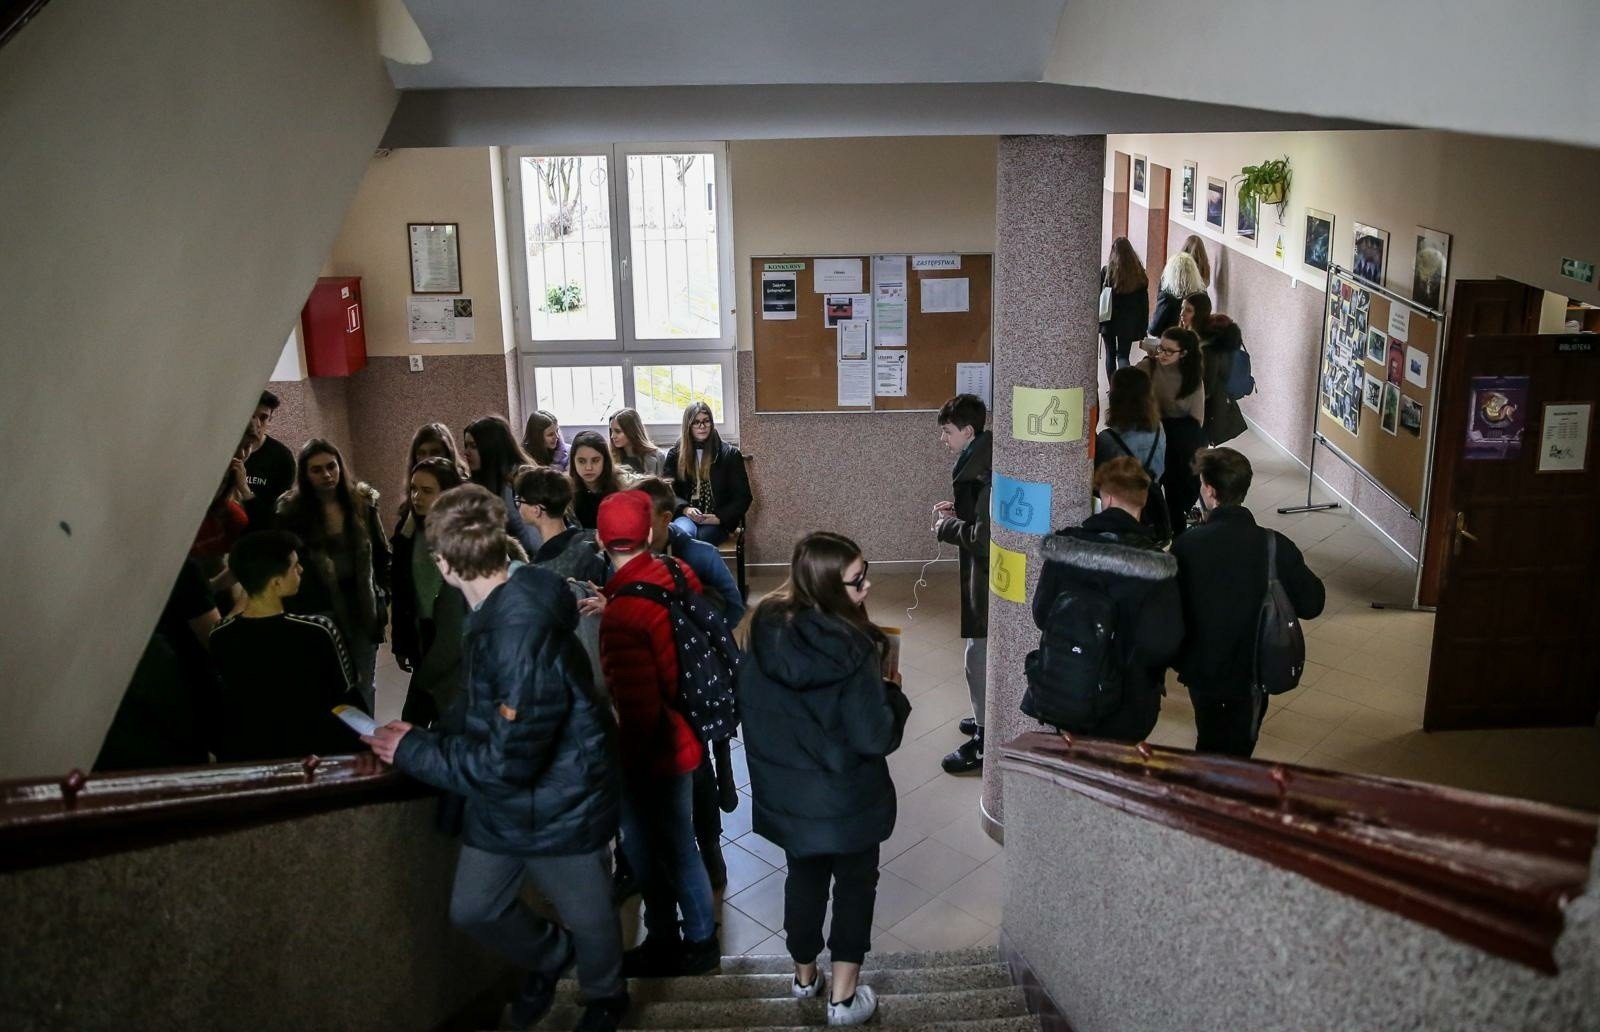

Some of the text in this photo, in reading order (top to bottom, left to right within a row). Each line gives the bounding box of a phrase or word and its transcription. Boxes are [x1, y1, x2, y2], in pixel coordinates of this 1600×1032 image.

[916, 259, 955, 267] ZASTĘPSTWA
[1050, 418, 1059, 426] IX
[245, 476, 267, 486] KLEIN
[1015, 507, 1023, 517] IX
